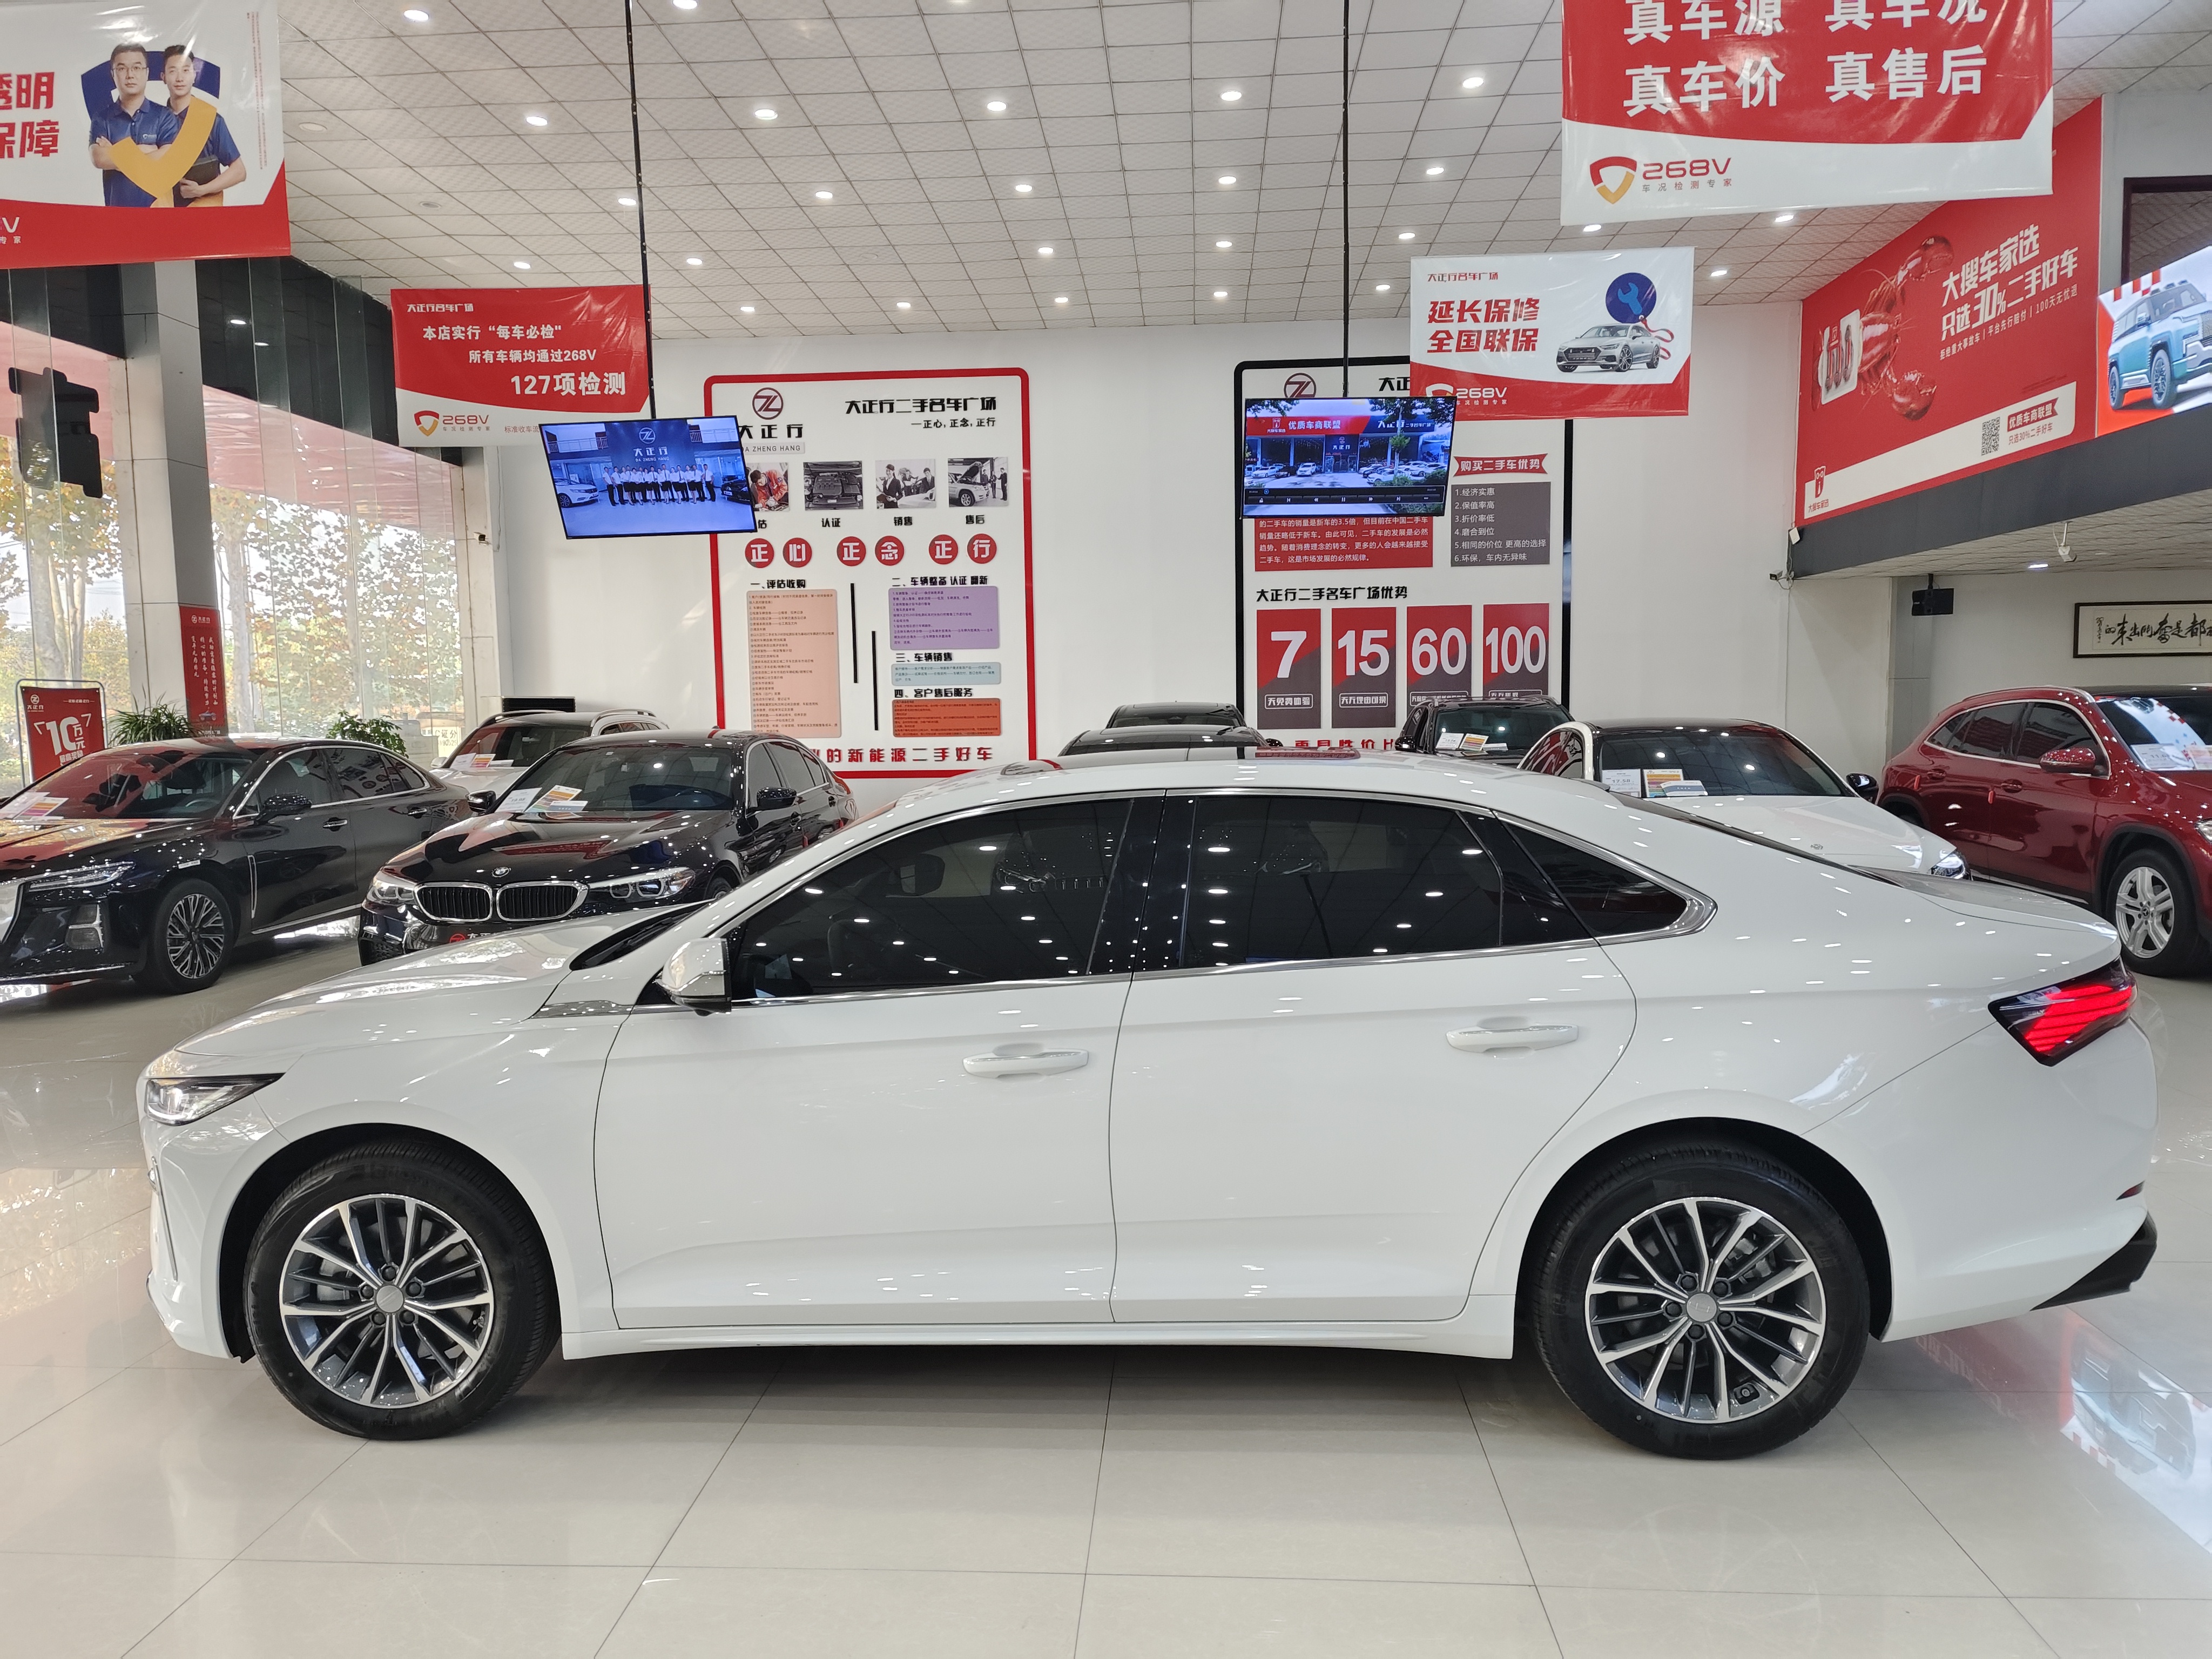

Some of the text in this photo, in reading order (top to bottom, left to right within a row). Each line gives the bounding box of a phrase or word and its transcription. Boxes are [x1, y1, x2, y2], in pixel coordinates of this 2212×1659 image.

[1623, 44, 1987, 118] 真车价 真售后
[1642, 157, 1732, 180] 268V
[1642, 178, 1732, 192] 车况检测专家
[1942, 224, 2039, 307] 大搜车家选
[1427, 272, 1499, 282] 大正行名车广场
[1941, 247, 2079, 341] 只选30%二手好车
[407, 304, 474, 313] 大正行名车广场
[1427, 298, 1540, 323] 延长保修
[1427, 328, 1539, 353] 全国联保
[469, 349, 597, 364] 所有车辆均通过268V
[511, 372, 625, 396] 127项检测
[1456, 387, 1508, 399] 268V
[845, 396, 997, 415] 大正行二手名车广场
[442, 414, 489, 425] 268V
[2009, 402, 2053, 429] 优质车商联盟
[1288, 420, 1341, 430] 优质车商联盟
[633, 446, 669, 457] 大正行
[1461, 458, 1540, 471] 购买二手车优势
[1455, 487, 1495, 496] 1.经济实惠
[1454, 501, 1495, 510] 2.保值率高
[821, 517, 841, 528] 认证
[893, 516, 913, 527] 销售
[965, 514, 986, 525] 售后
[1454, 514, 1495, 523] 3.折价率低
[1454, 527, 1495, 536] 4.磨合到位
[1454, 539, 1547, 549] 5.相同的价位 更高的选择
[750, 579, 806, 589] 一、评估收购
[892, 576, 947, 586] 二、车辆整备
[950, 576, 967, 585] 认证
[1256, 586, 1407, 602] 大正行二手名车广场优势
[1271, 631, 1307, 678] 7
[1338, 629, 1390, 676] 15
[1412, 627, 1467, 676] 60
[1486, 626, 1546, 674] 100
[896, 652, 953, 663] 三、车辆销售
[894, 688, 973, 698] 四、客户售后服务
